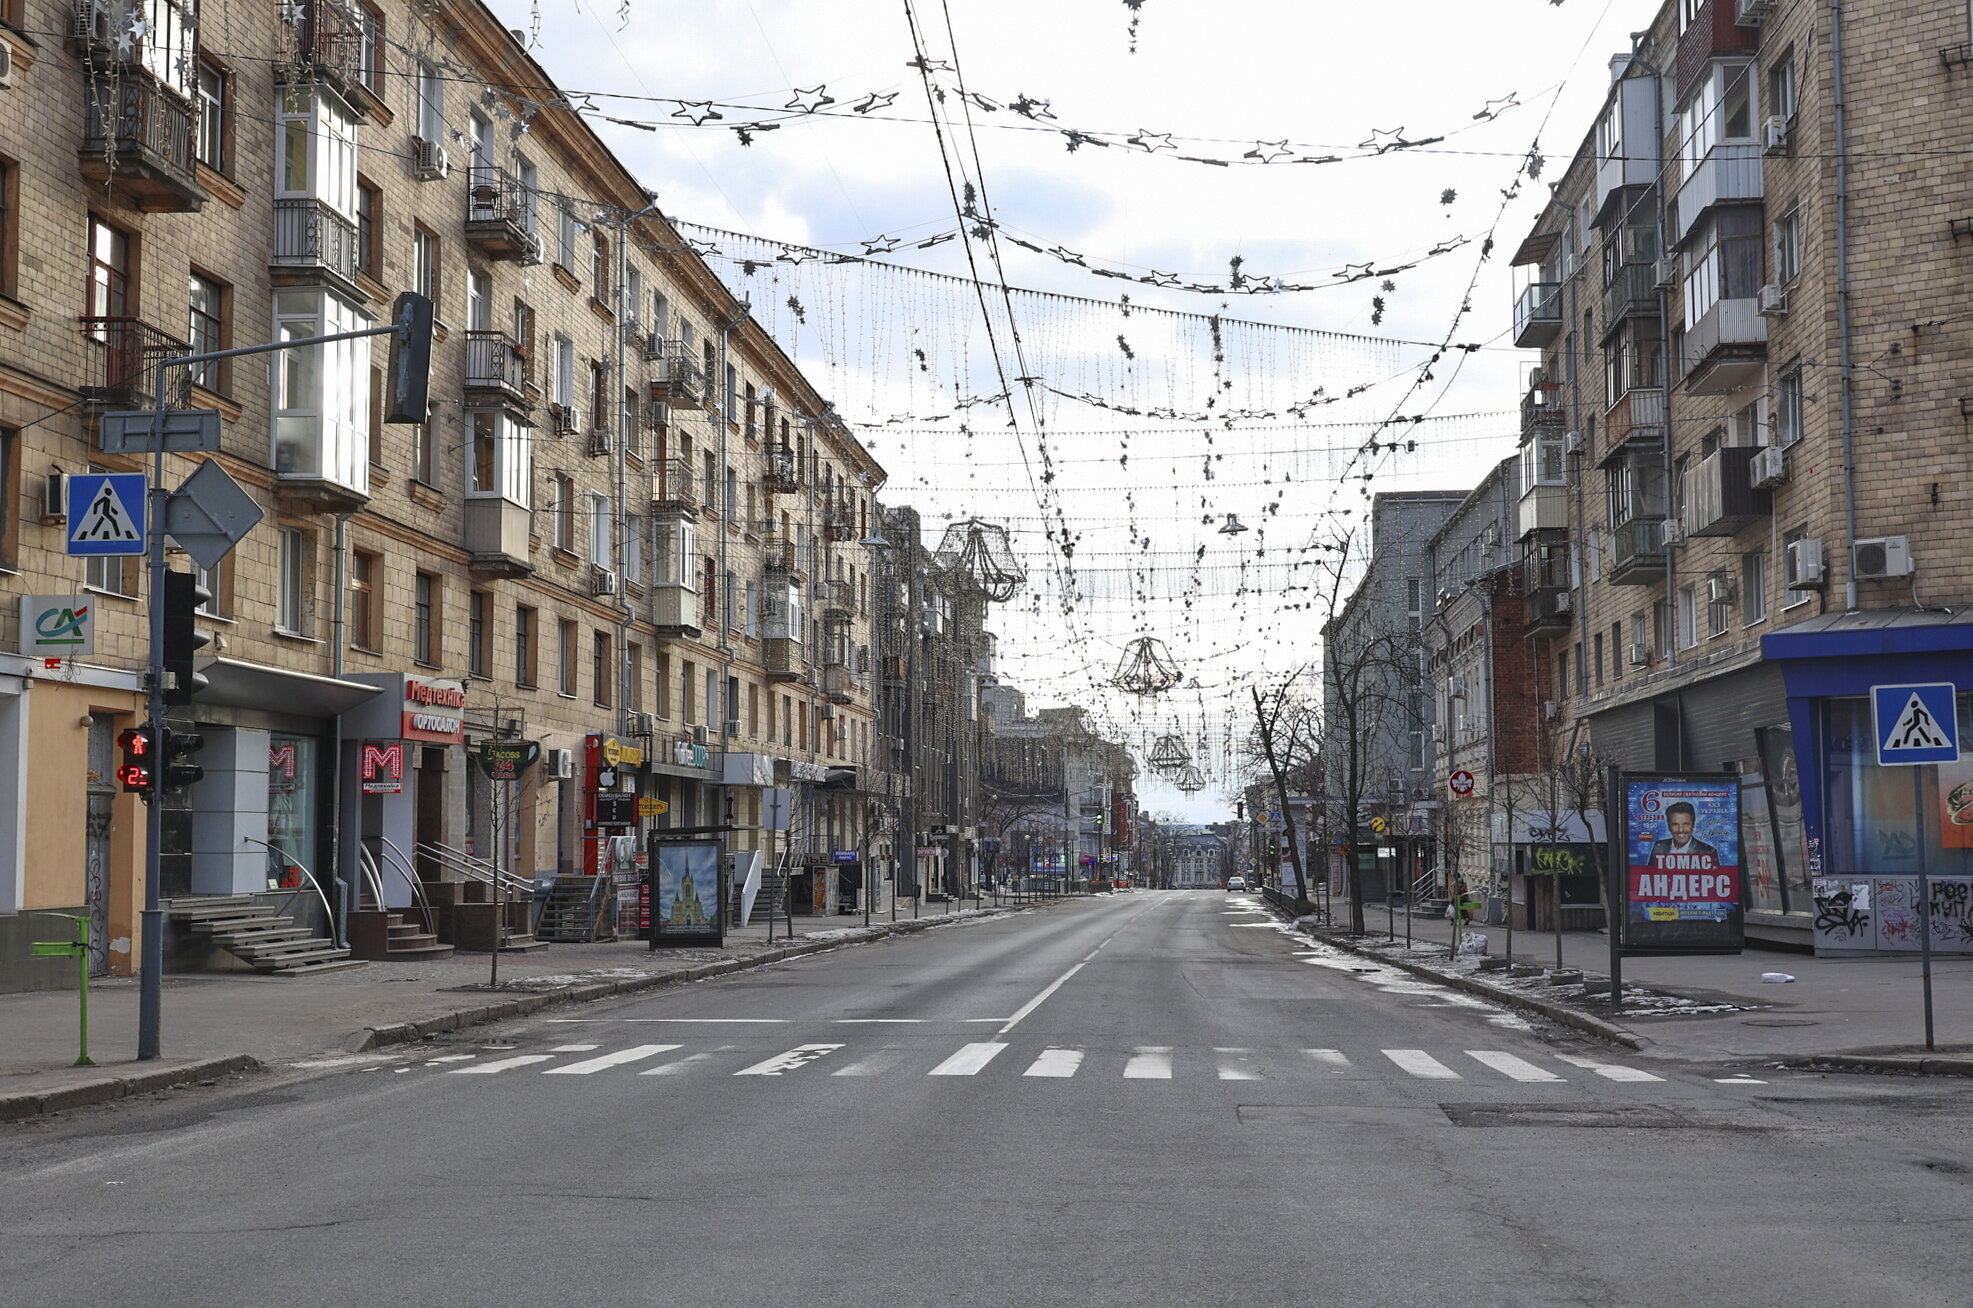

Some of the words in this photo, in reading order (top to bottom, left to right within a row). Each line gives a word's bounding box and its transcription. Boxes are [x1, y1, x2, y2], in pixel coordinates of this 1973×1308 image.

[407, 680, 466, 709] Медтехніка
[495, 759, 514, 771] 24
[1640, 790, 1662, 814] 6
[1656, 855, 1712, 870] ТОМАС
[1638, 874, 1731, 901] АНДЕРС
